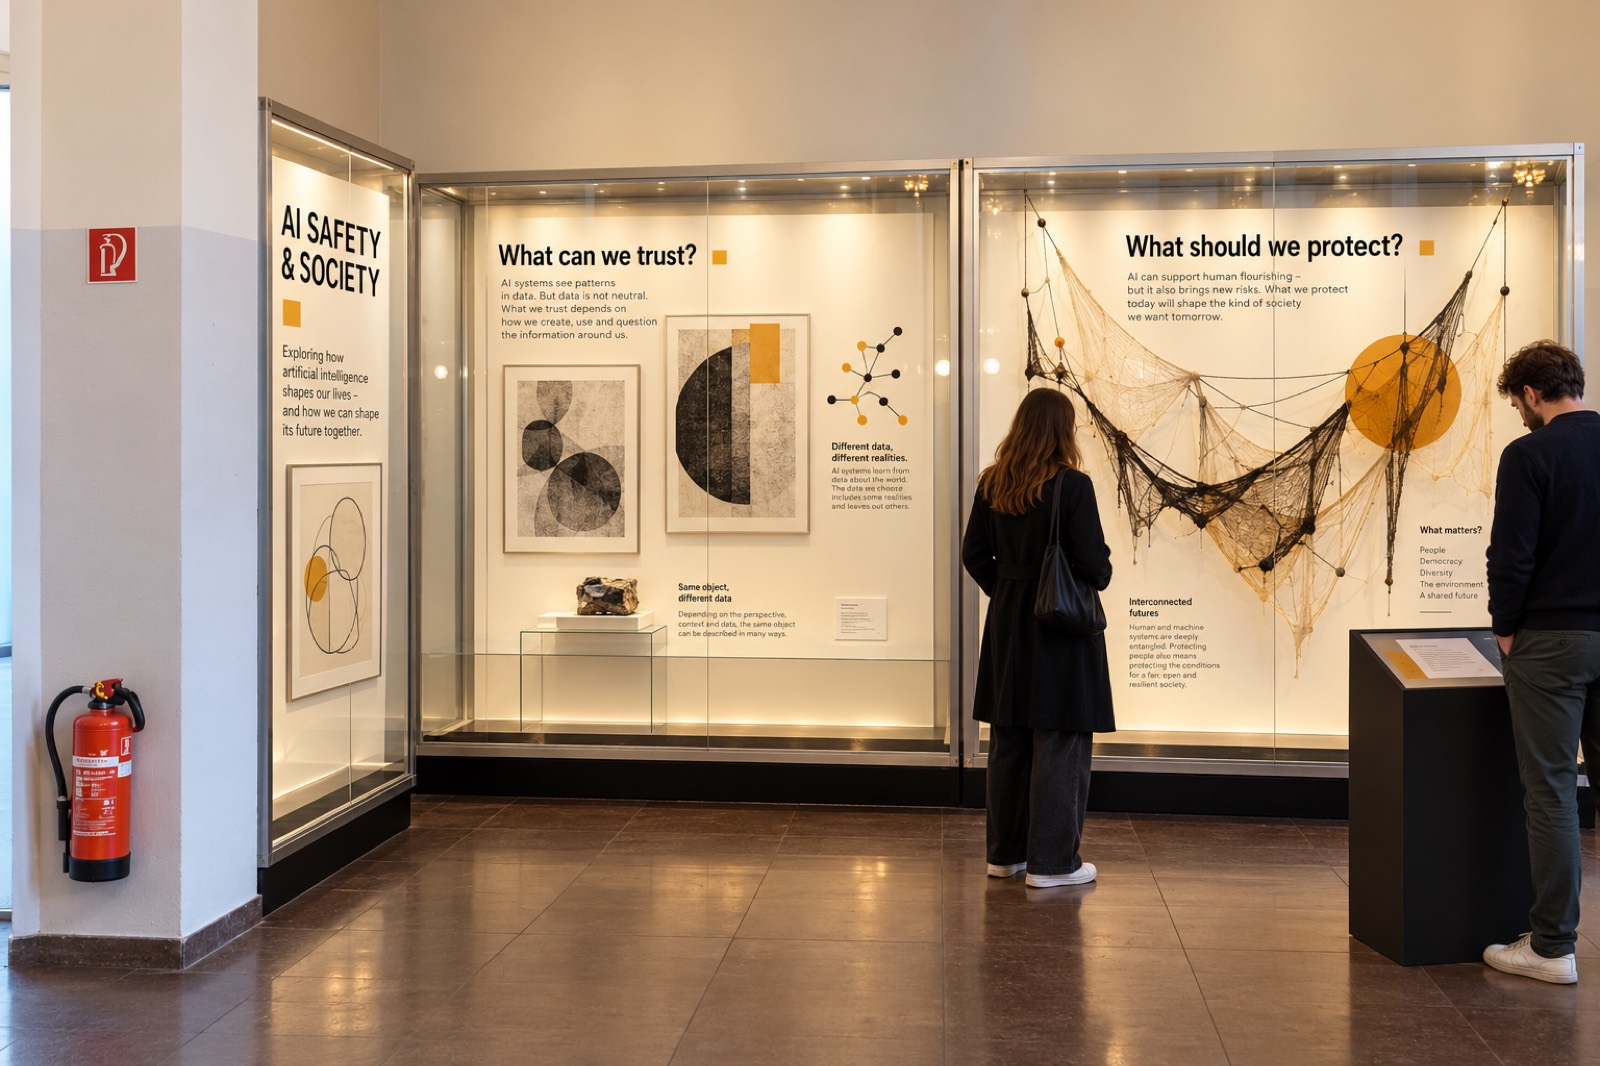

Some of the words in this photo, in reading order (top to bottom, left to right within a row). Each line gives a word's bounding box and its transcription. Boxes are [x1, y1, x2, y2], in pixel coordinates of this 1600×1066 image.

[281, 205, 300, 239] AI
[306, 212, 381, 260] SAFETY
[1126, 235, 1183, 257] What
[1190, 234, 1260, 257] should
[1268, 240, 1300, 256] we
[1308, 233, 1403, 262] protect?
[499, 244, 553, 265] What
[559, 250, 595, 265] can
[601, 250, 630, 265] we
[637, 243, 696, 265] trust?
[282, 247, 295, 280] &
[300, 250, 379, 297] SOCIETY
[1128, 273, 1137, 281] AI
[1161, 274, 1200, 283] support
[1203, 272, 1237, 281] human
[1240, 272, 1292, 283] flourishing
[501, 279, 511, 287] AI
[515, 280, 553, 289] systems
[575, 280, 615, 289] patterns
[502, 291, 509, 300] in
[512, 292, 536, 300] data.
[540, 291, 555, 300] But
[559, 291, 579, 300] data
[583, 291, 590, 300] is
[593, 292, 608, 300] not
[612, 291, 648, 300] neutral.
[1128, 286, 1144, 295] but
[1147, 286, 1153, 294] it
[1156, 286, 1175, 294] also
[1179, 286, 1209, 296] brings
[1236, 285, 1260, 294] risks.
[1265, 285, 1291, 293] What
[1311, 286, 1348, 295] protect
[1128, 300, 1155, 309] today
[1158, 299, 1174, 307] will
[1178, 299, 1206, 309] shape
[1210, 299, 1226, 307] the
[1229, 299, 1249, 307] kind
[1253, 299, 1263, 307] of
[1266, 299, 1301, 309] society
[571, 305, 612, 314] depends
[1145, 313, 1168, 321] want
[1172, 313, 1222, 321] tomorrow.
[502, 318, 521, 326] how
[541, 319, 573, 327] create,
[596, 317, 613, 326] and
[616, 317, 657, 328] question
[502, 331, 517, 339] the
[520, 330, 574, 339] information
[578, 330, 612, 339] around
[283, 345, 323, 364] Exploring
[326, 350, 344, 362] how
[283, 366, 318, 380] artificial
[321, 368, 368, 385] intelligence
[283, 385, 314, 400] shapes
[317, 390, 331, 399] our
[333, 388, 351, 400] lives
[283, 405, 299, 416] and
[303, 405, 321, 417] how
[324, 409, 335, 417] we
[338, 410, 352, 418] can
[355, 407, 379, 421] shape
[283, 424, 293, 436] its
[296, 424, 322, 436] future
[325, 425, 362, 439] together.
[832, 442, 869, 450] Different
[872, 442, 893, 451] data,
[832, 454, 869, 462] different
[1420, 526, 1442, 534] What
[1445, 526, 1482, 534] matters?
[1420, 546, 1446, 554] People
[1420, 558, 1463, 566] Democracy
[1420, 569, 1452, 578] Diversity
[702, 583, 729, 592] object,
[678, 594, 712, 602] different
[715, 594, 731, 602] data
[1129, 609, 1158, 617] futures
